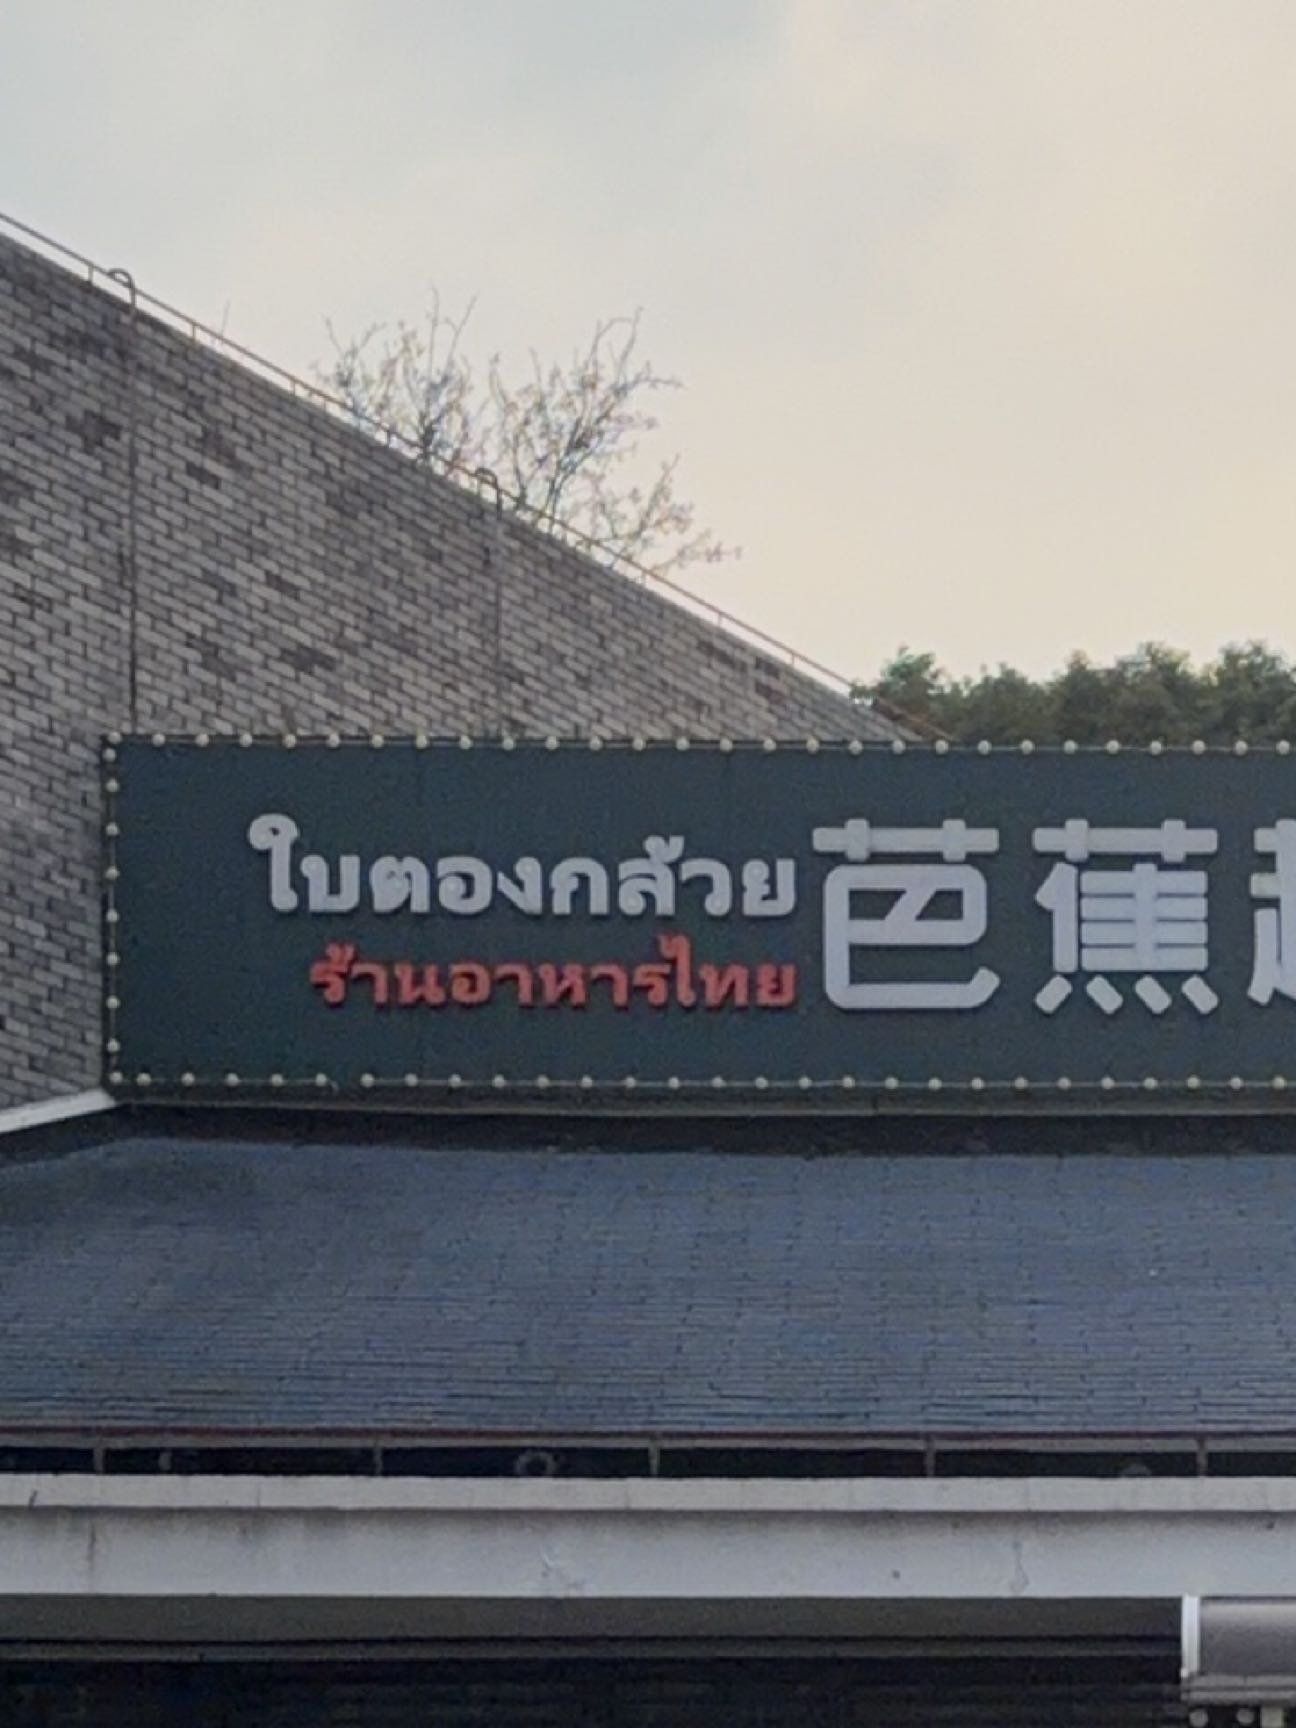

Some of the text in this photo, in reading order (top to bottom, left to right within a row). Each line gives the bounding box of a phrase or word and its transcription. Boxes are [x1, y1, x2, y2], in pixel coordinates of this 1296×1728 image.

[248, 813, 797, 917] ใบตองกล้วย
[310, 933, 797, 1006] ร้านอาหารไทย
